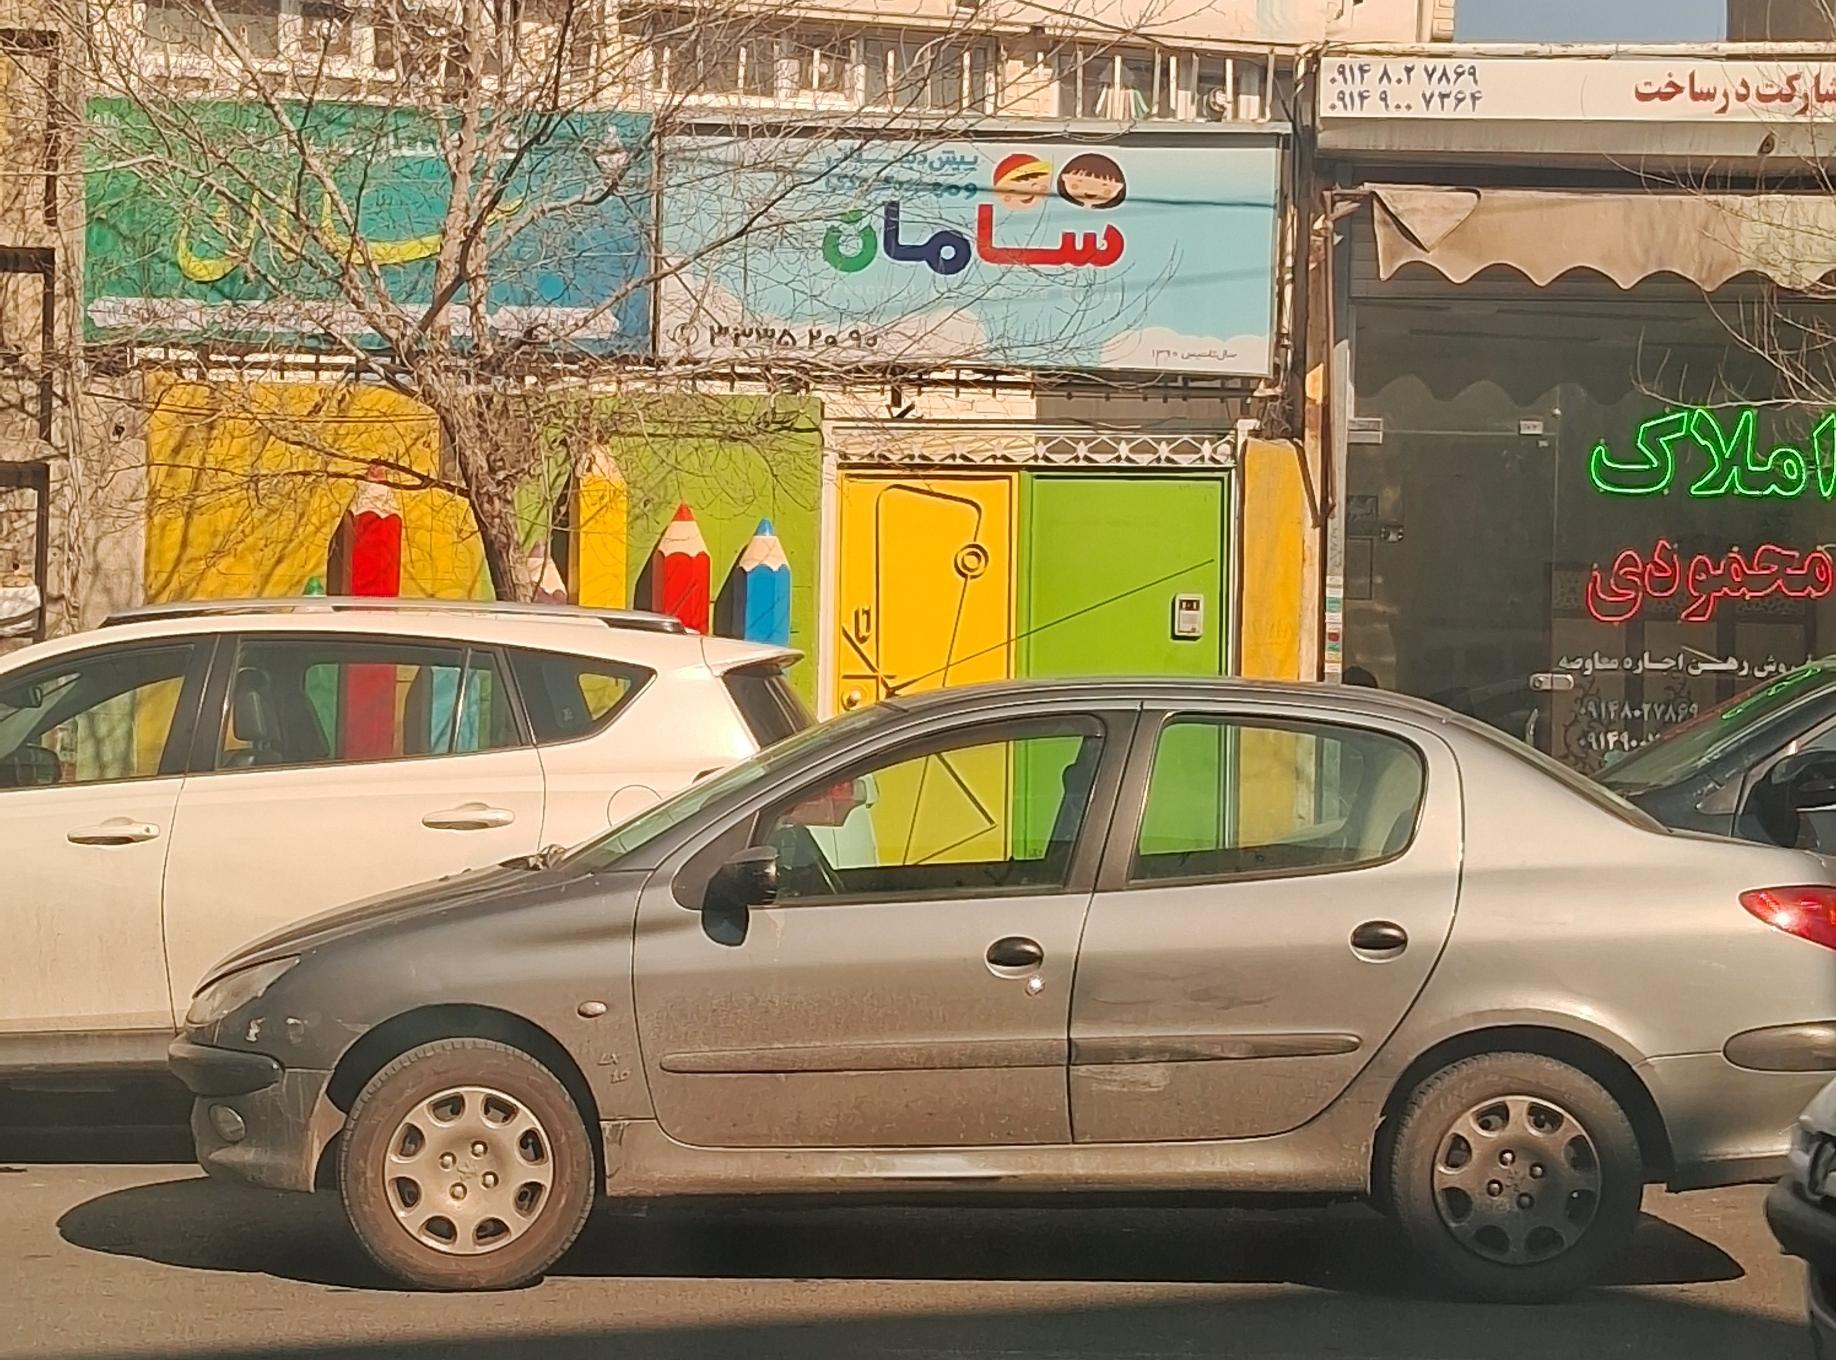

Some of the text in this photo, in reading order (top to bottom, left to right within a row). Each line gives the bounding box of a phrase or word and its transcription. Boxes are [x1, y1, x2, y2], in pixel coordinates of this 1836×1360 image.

[1329, 63, 1478, 86] ۰۹۱۴ ۸۰۲ ۷۸۶۹
[1634, 70, 1836, 117] شارکت در ساخت
[1329, 89, 1483, 112] ۰۹۱۴ ۹۰۰ ۷۳۶۴
[822, 200, 1125, 276] سامان
[1591, 408, 1836, 497] املاک
[1585, 540, 1834, 622] محمودی
[1623, 651, 1684, 674] اجاره
